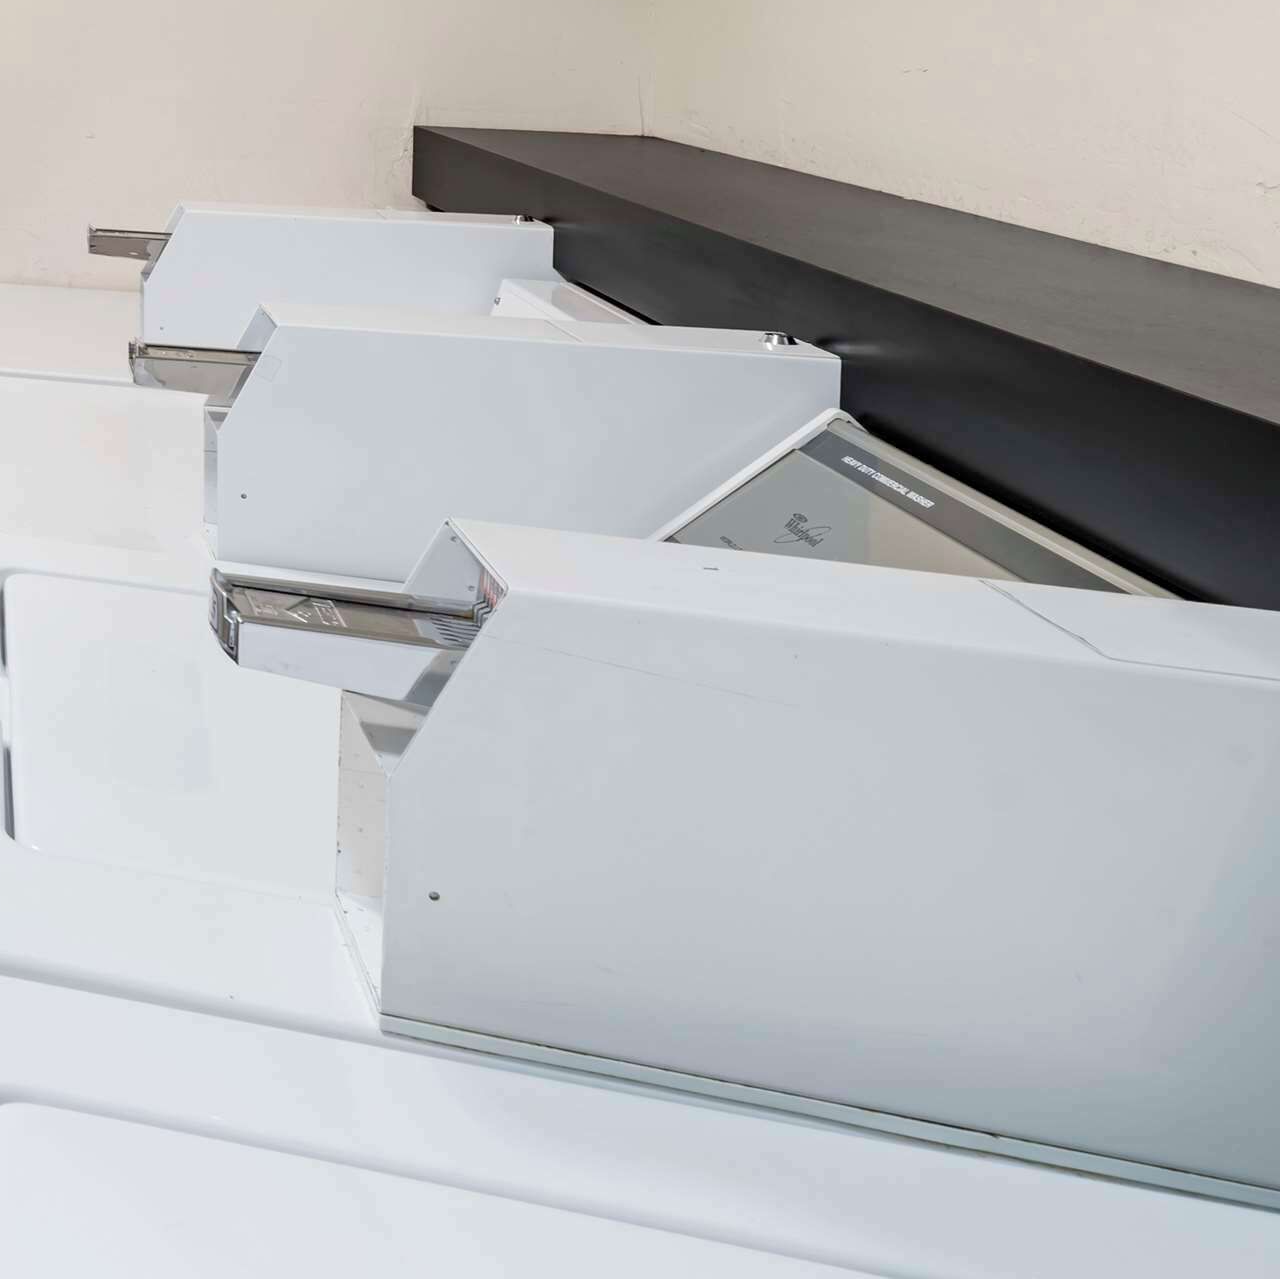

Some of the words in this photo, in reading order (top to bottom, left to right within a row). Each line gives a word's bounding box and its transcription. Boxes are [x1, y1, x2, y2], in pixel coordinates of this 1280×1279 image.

[840, 455, 862, 469] HEAVY
[857, 464, 876, 477] DUTY
[871, 472, 910, 496] COMMERCIAL
[906, 490, 936, 509] WASHER
[782, 517, 826, 549] Whirlpool
